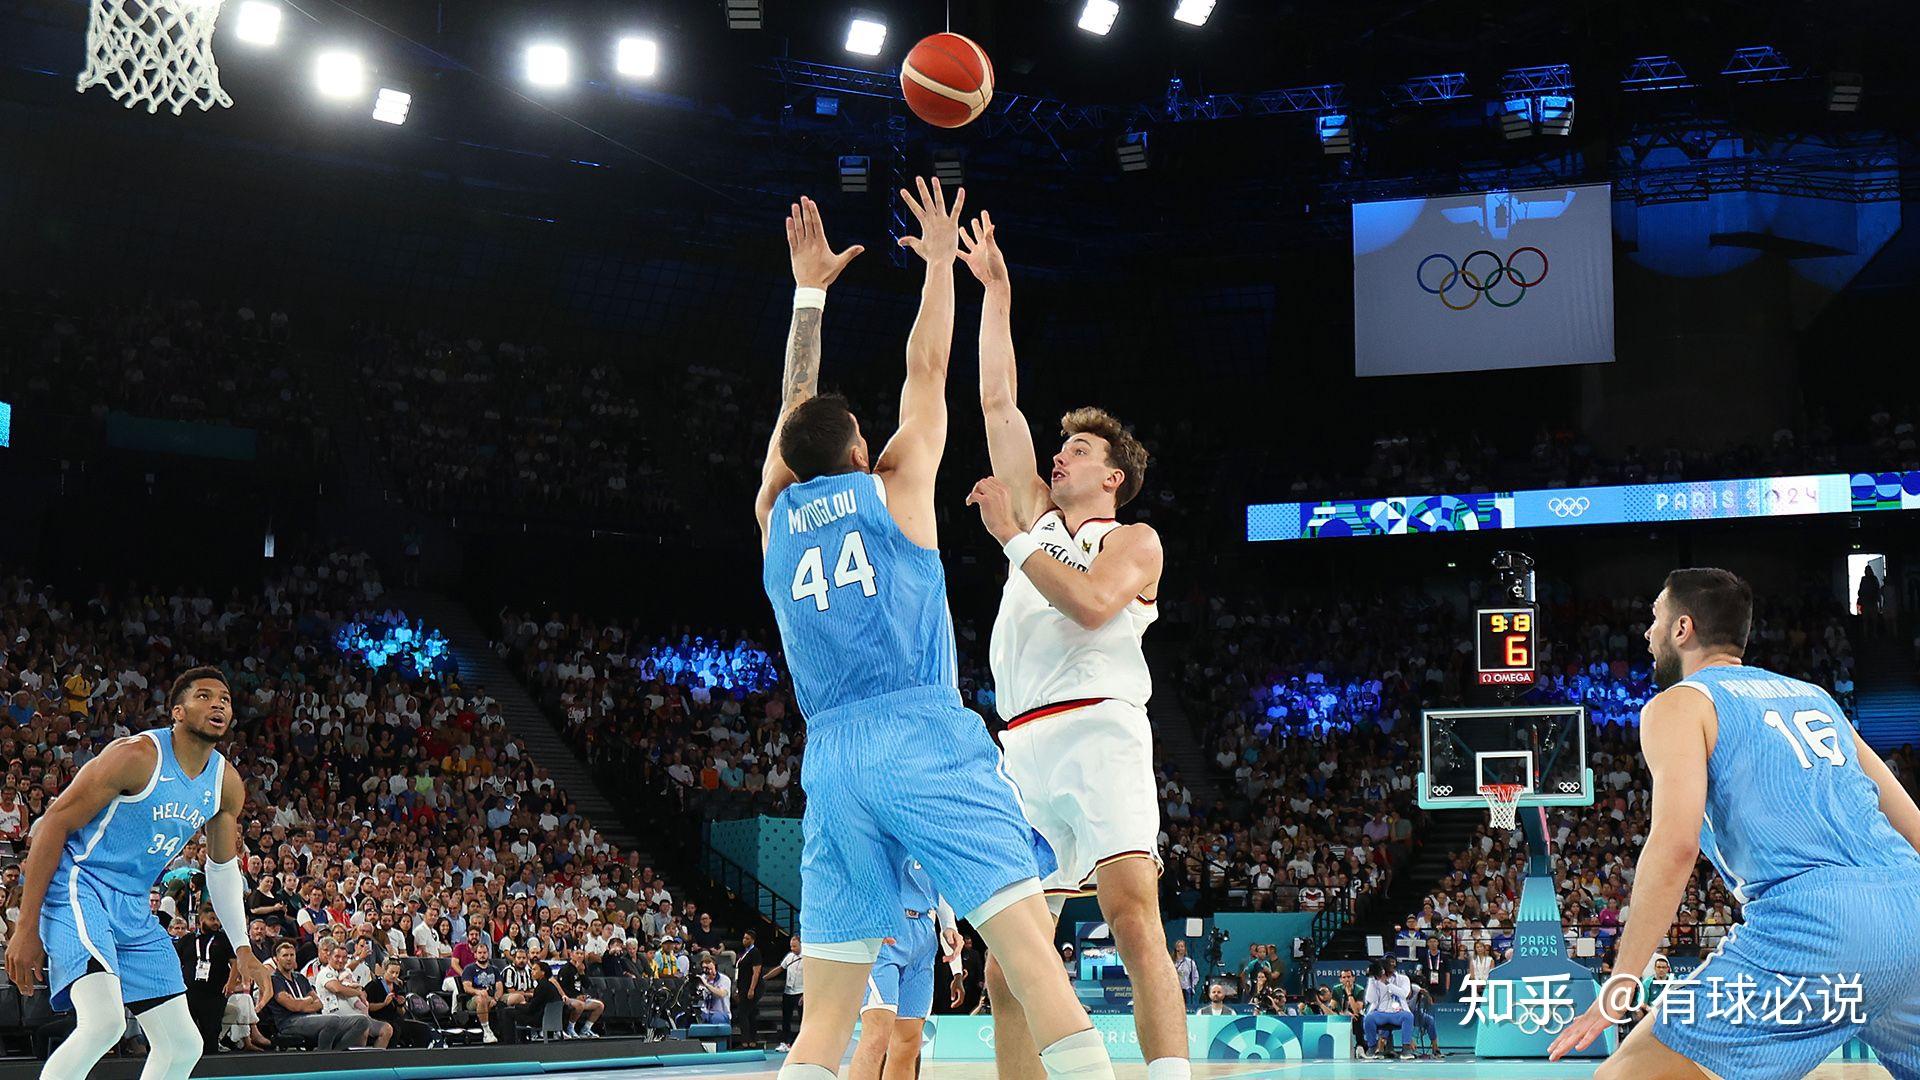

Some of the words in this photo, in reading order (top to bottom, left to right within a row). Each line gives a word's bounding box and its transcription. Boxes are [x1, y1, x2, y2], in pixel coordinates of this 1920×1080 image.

[1656, 490, 1735, 511] PARIS
[1745, 487, 1817, 508] 2024
[791, 530, 878, 612] 44
[1505, 635, 1528, 666] 6
[1493, 672, 1532, 683] OMEGA
[1763, 709, 1848, 769] 16
[152, 802, 206, 829] HELLAS
[147, 833, 181, 857] 34
[1520, 935, 1558, 946] PARIS
[1520, 946, 1558, 957] 2024
[1316, 969, 1341, 977] PARIS
